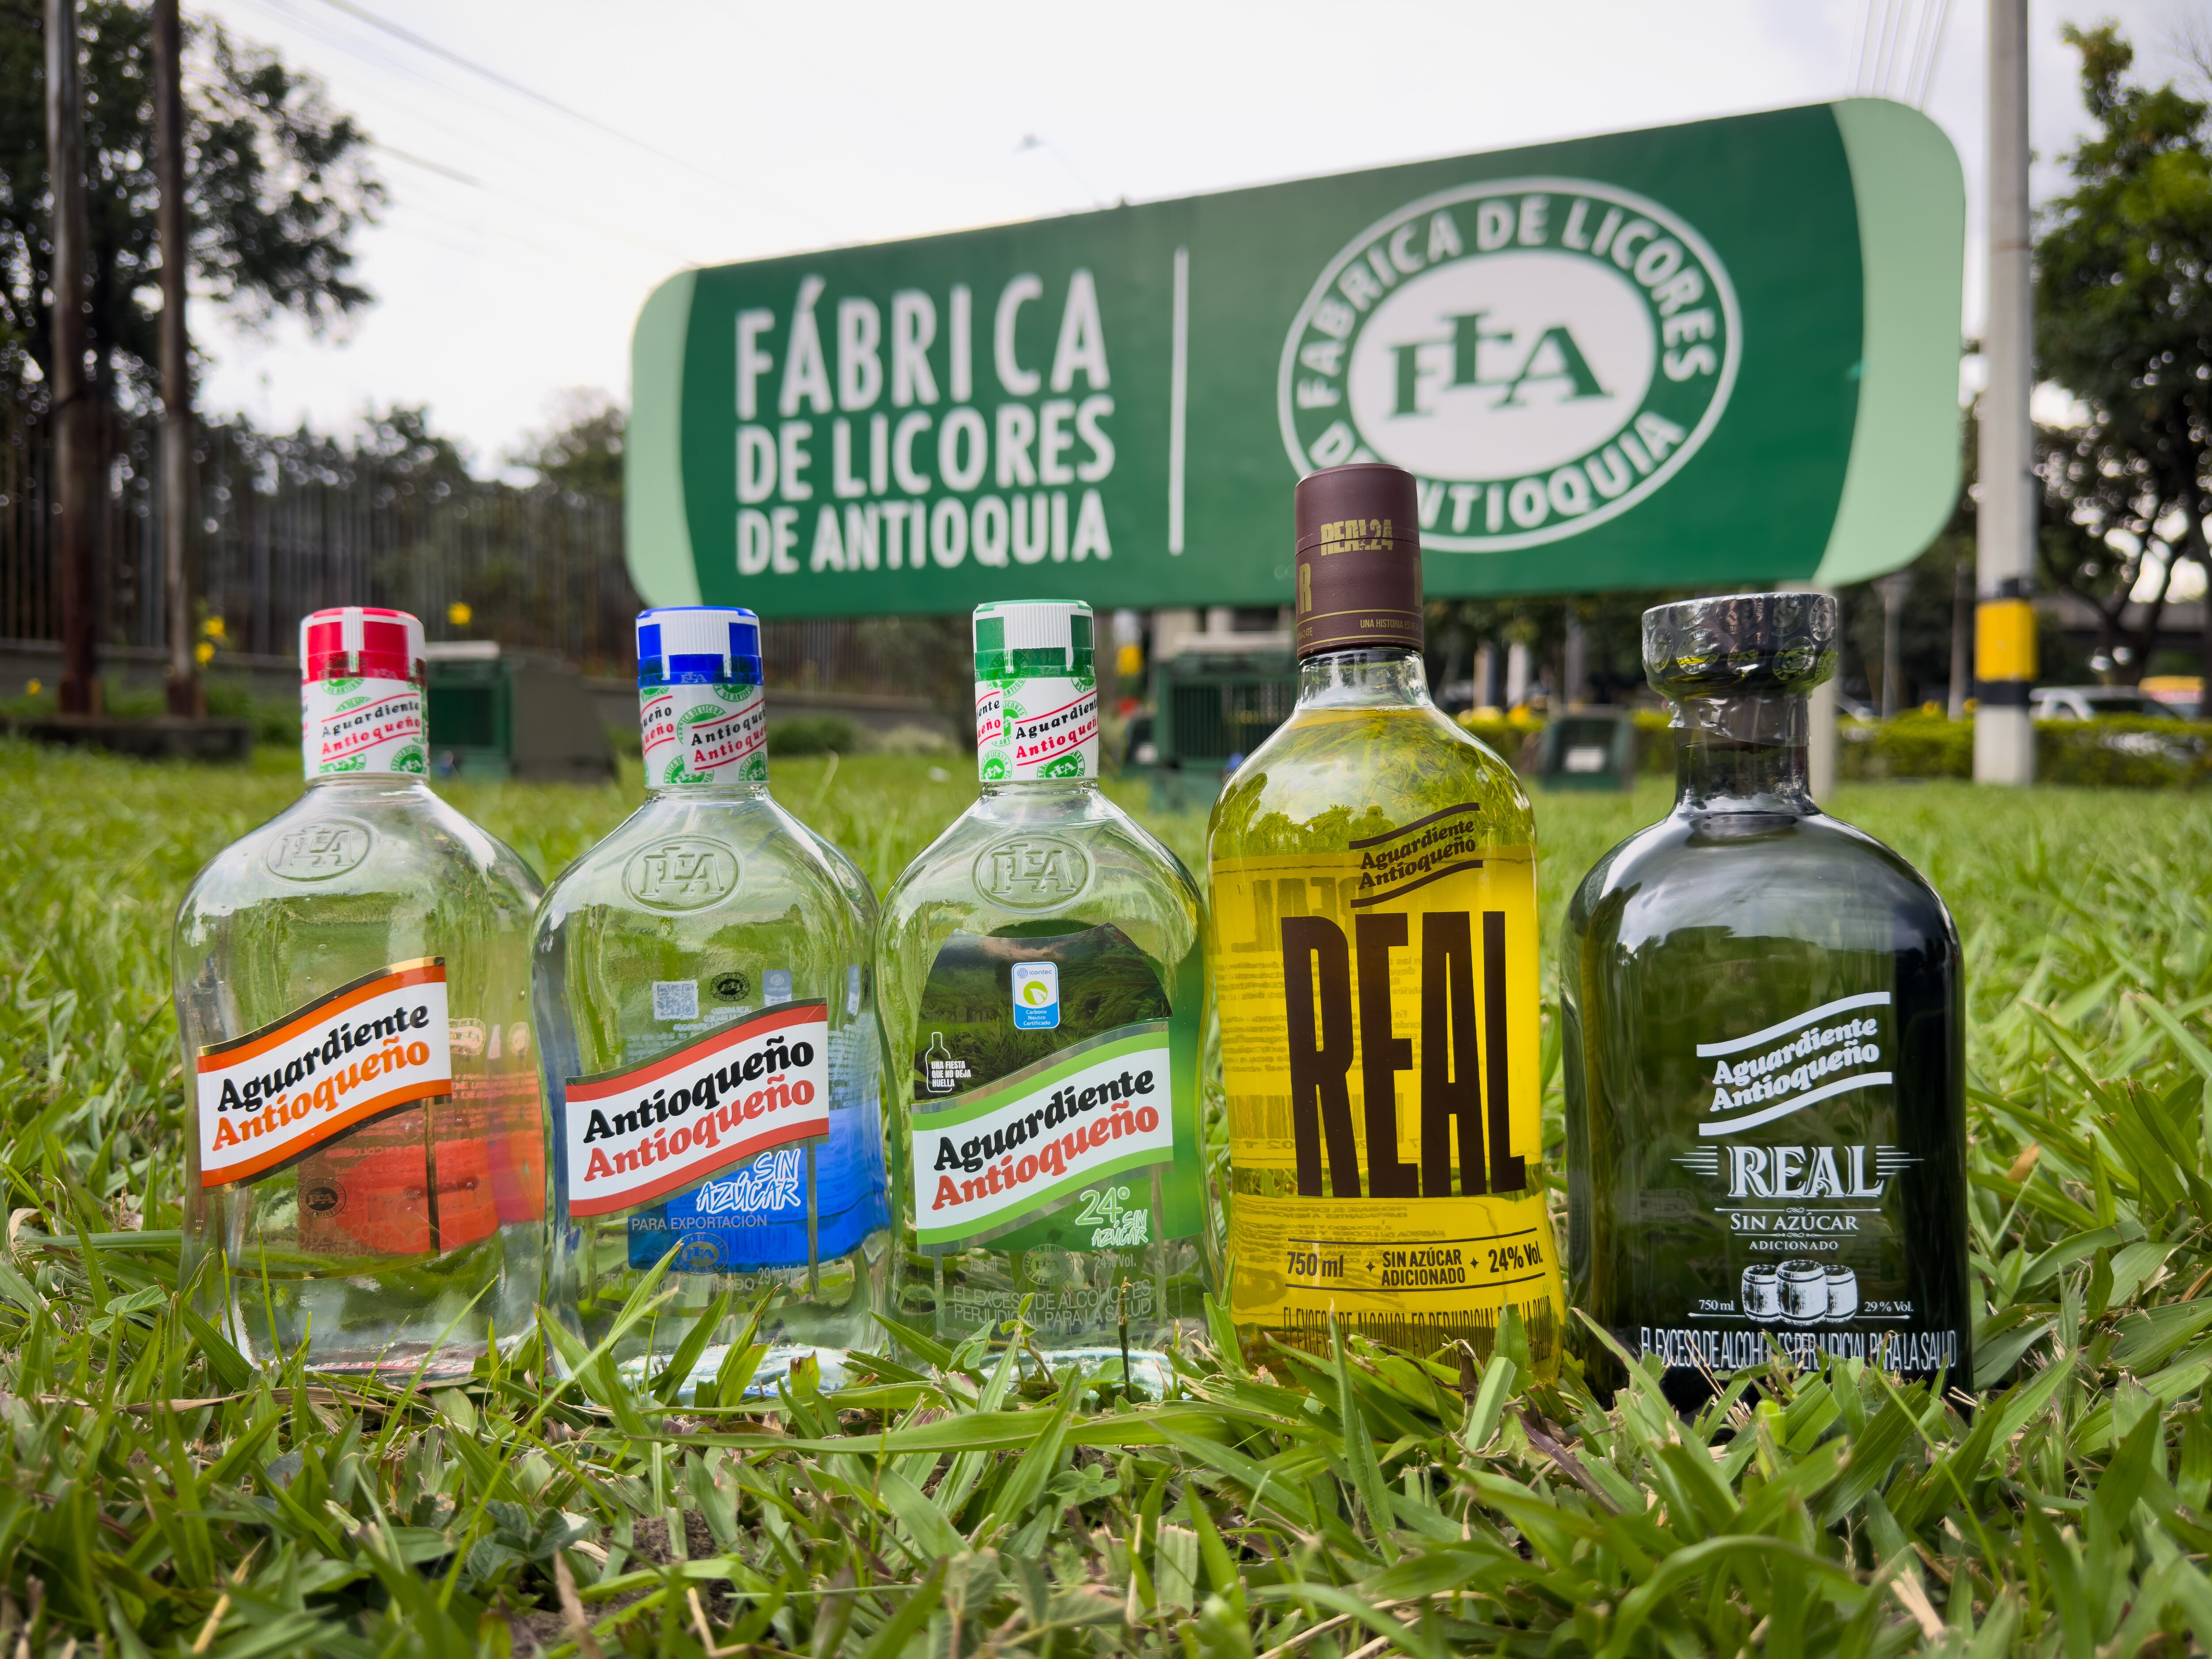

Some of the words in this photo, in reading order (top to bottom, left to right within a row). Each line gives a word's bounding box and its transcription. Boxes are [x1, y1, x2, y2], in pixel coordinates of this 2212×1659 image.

[1477, 195, 1550, 250] DE
[1562, 198, 1717, 382] LICORES
[733, 268, 1111, 421] FÁBRICA
[1388, 309, 1614, 419] FLA
[736, 419, 814, 505] DE
[832, 395, 1116, 500] LICORES
[1419, 411, 1689, 532] NTIOQUIA
[736, 507, 799, 576] DE
[811, 488, 1112, 573] ANTIOQUIA
[1360, 619, 1374, 628] UNA
[1376, 619, 1403, 629] HISTORIA
[321, 716, 421, 755] Antioqueño
[322, 701, 420, 737] Aguardiente
[1358, 836, 1475, 890] Antioqueño
[1360, 820, 1475, 870] Aguardiente
[991, 843, 1078, 894] FLA
[217, 1005, 430, 1112] Aguardiente
[931, 1061, 944, 1070] UNA
[945, 1060, 966, 1070] FIESTA
[1281, 911, 1527, 1198] REAL
[1712, 1018, 1878, 1087] Aguardiente
[212, 1037, 430, 1152] Antioqueño
[583, 1035, 814, 1144] Antioqueño
[932, 1070, 944, 1079] QUE
[945, 1069, 954, 1078] NO
[955, 1069, 972, 1078] DEJA
[932, 1079, 955, 1087] HUELLA
[1709, 1040, 1879, 1112] Antioqueño
[584, 1073, 815, 1182] Antioqueño
[933, 1069, 1155, 1173] Aguardiente
[753, 1148, 801, 1183] SIN
[931, 1100, 1159, 1210] Antioqueño
[1726, 1145, 1885, 1198] REAL
[696, 1172, 801, 1214] AZÚCAR
[632, 1218, 667, 1230] PARA
[671, 1214, 767, 1230] EXPORTACIÓN
[1091, 1220, 1148, 1247] AZÚCAR
[1122, 1209, 1148, 1229] SIN
[1730, 1213, 1767, 1231] SIN
[1773, 1212, 1860, 1231] AZÚCAR
[1287, 1251, 1317, 1277] 750
[1321, 1254, 1344, 1278] ml
[1382, 1251, 1406, 1268] SIN
[1409, 1247, 1462, 1267] AZÚCAR
[1488, 1248, 1524, 1273] 24%
[1525, 1240, 1544, 1265] Vol.
[1748, 1240, 1839, 1251] ADICIONADO
[1036, 1292, 1055, 1310] DE
[1133, 1279, 1151, 1298] ES
[1381, 1267, 1466, 1286] ADICIONADO
[1045, 1310, 1083, 1326] PARA
[1085, 1306, 1103, 1324] LA
[1698, 1299, 1718, 1311] 750
[1720, 1299, 1735, 1311] ml
[1893, 1301, 1914, 1312] Vol.
[1656, 1329, 1701, 1368] EXCESO
[1703, 1330, 1720, 1369] DE
[1904, 1333, 1920, 1370] LA
[1921, 1330, 1957, 1370] SALUD
